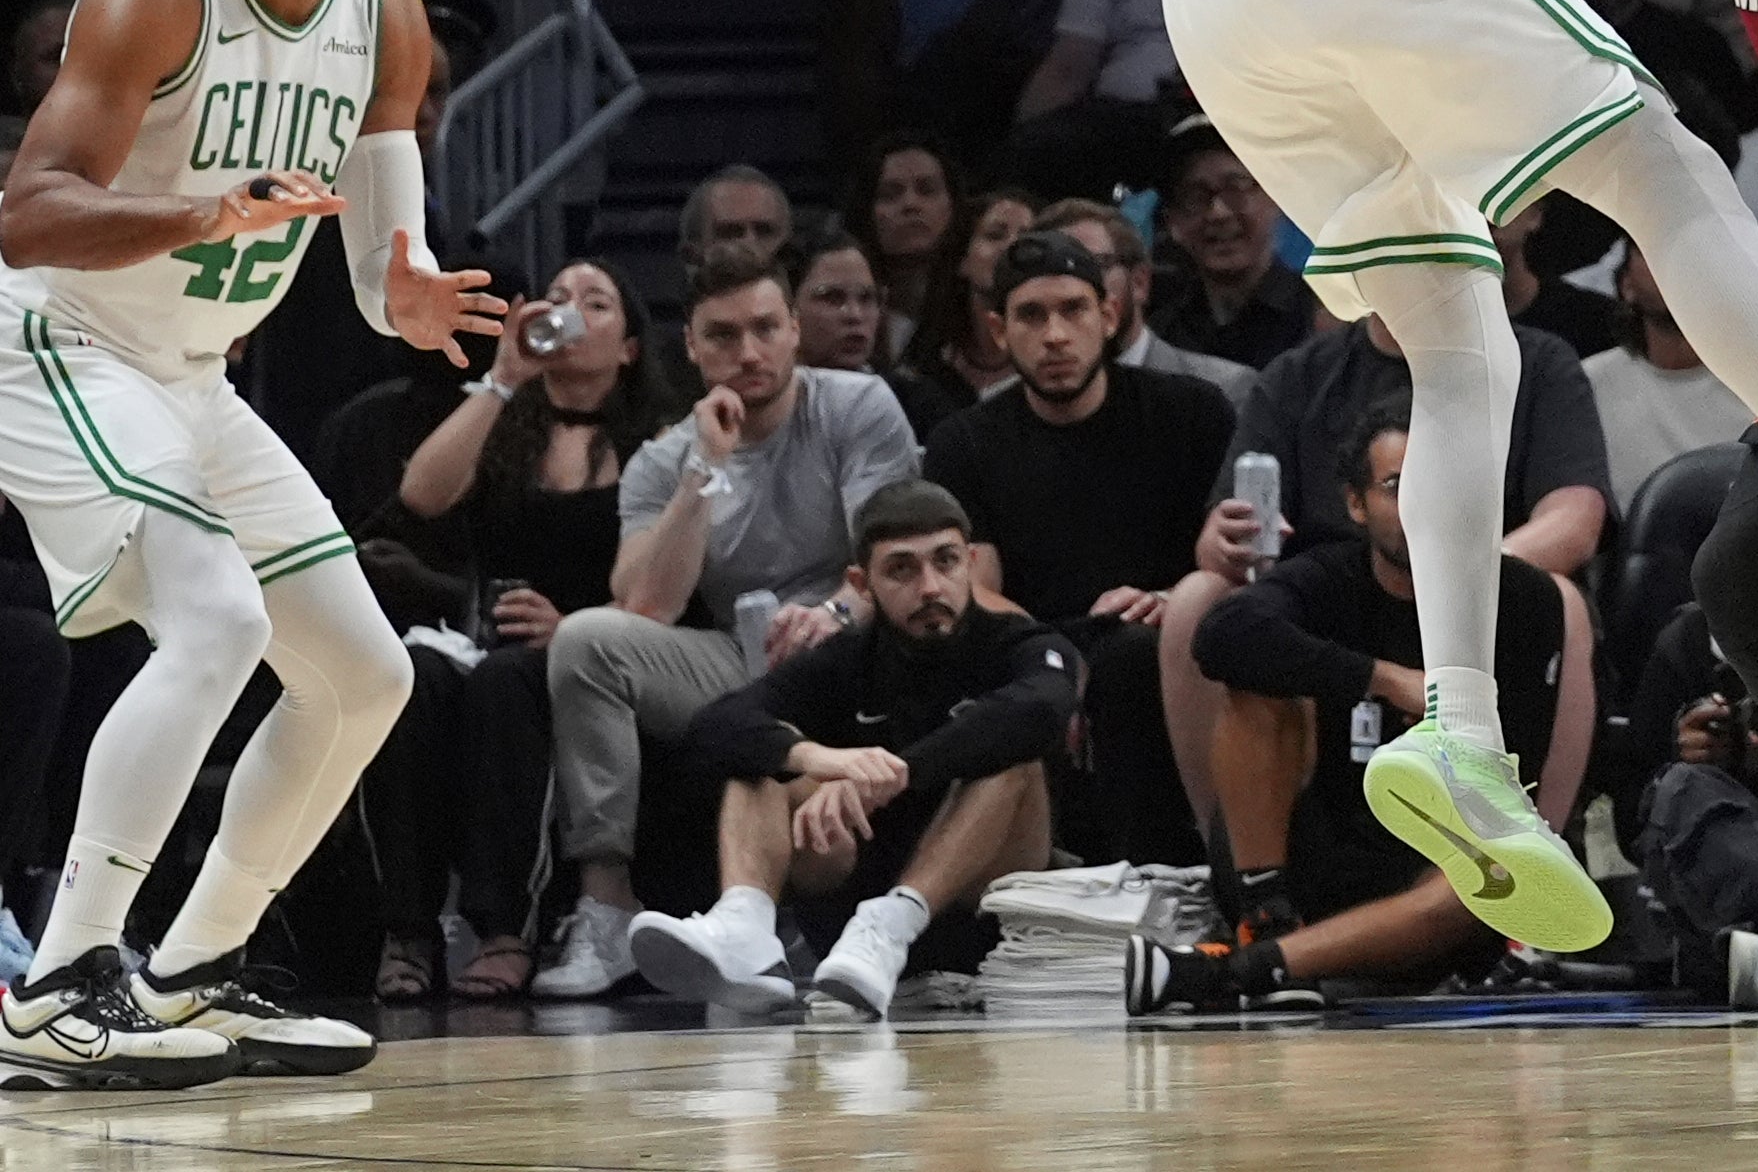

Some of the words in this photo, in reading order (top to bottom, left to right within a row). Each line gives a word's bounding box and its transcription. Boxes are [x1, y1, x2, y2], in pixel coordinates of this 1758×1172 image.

[322, 36, 368, 56] Amica
[189, 81, 356, 185] CELTICS
[170, 215, 306, 303] 42
